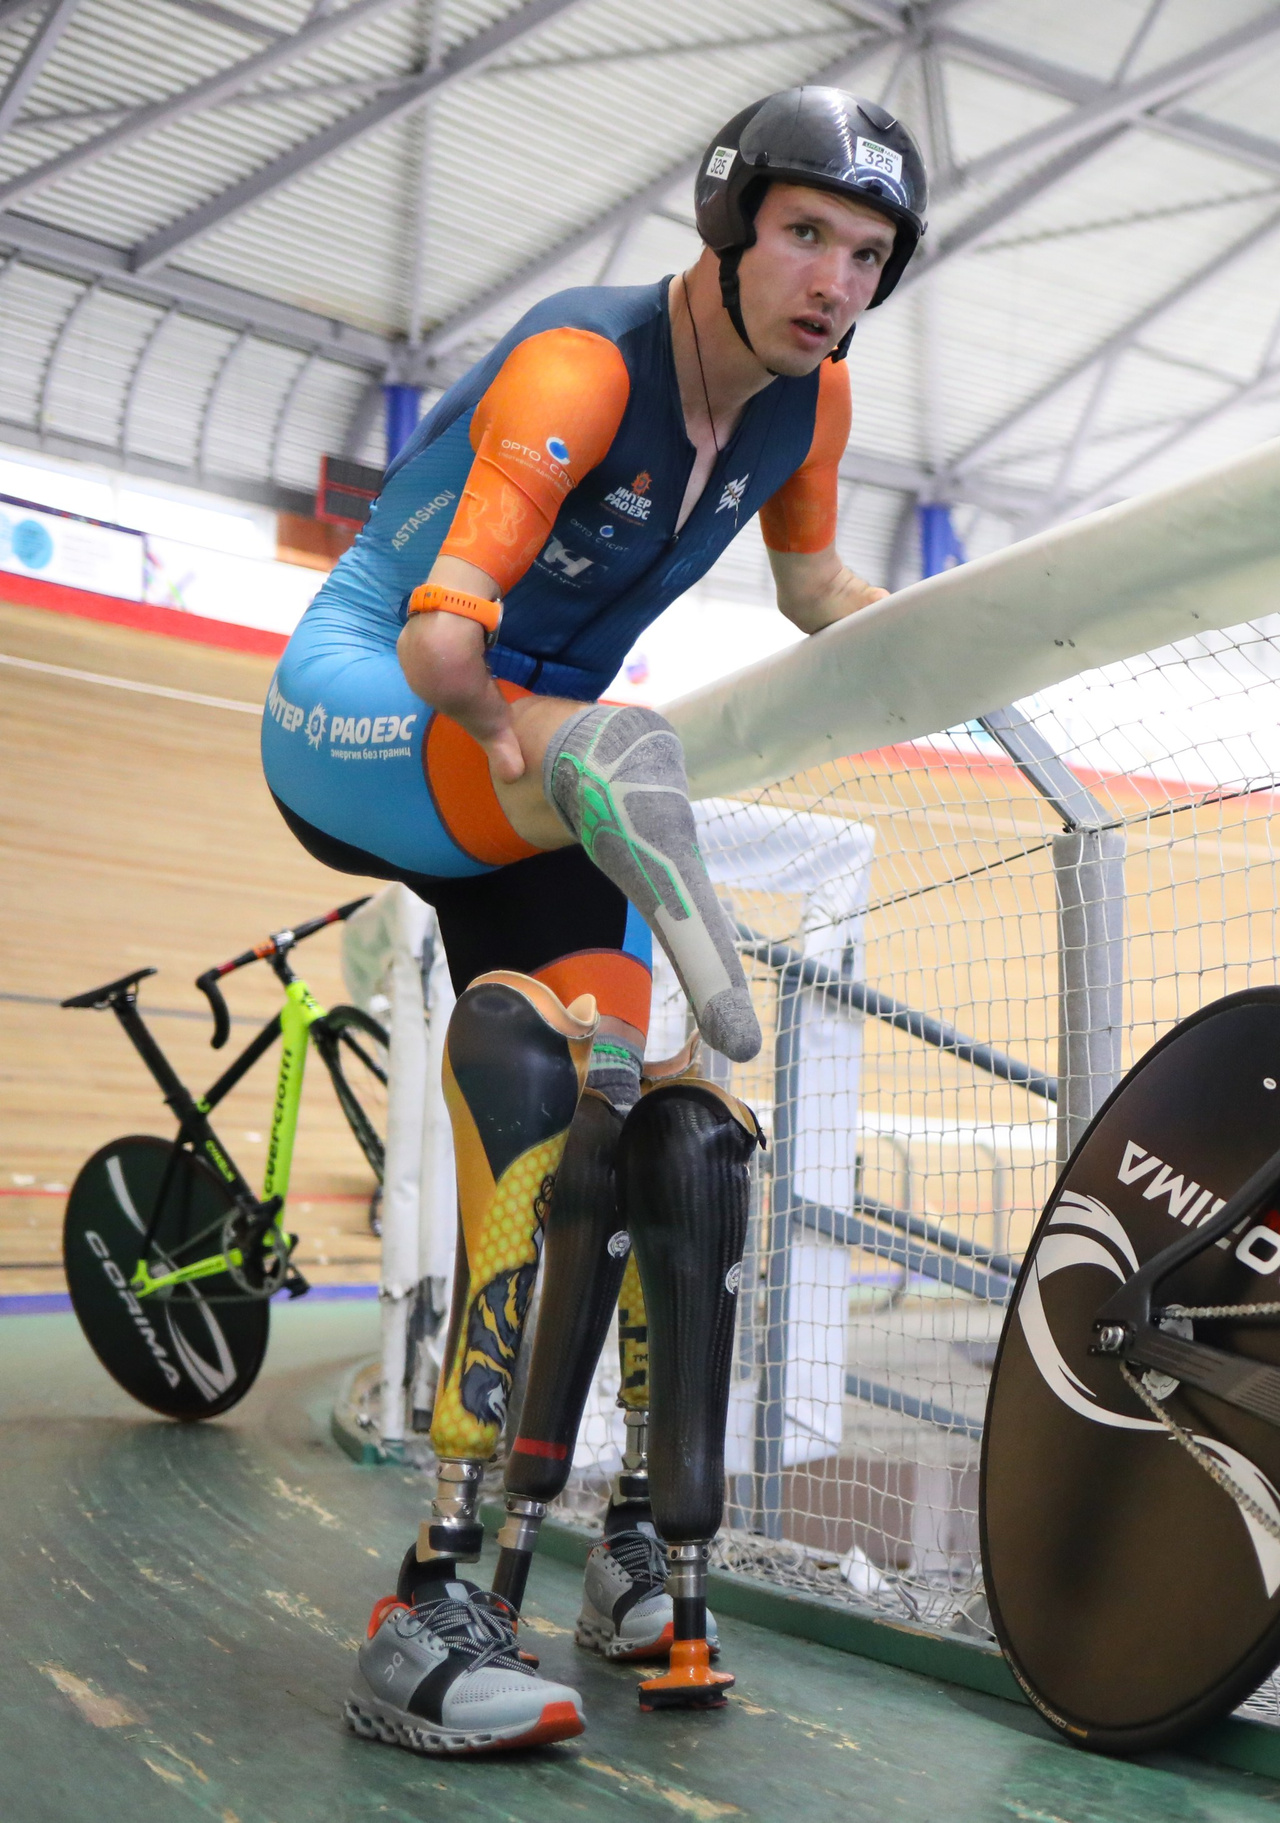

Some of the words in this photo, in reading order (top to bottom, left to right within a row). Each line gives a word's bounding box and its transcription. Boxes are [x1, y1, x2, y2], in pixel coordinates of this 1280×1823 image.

[710, 158, 727, 175] 325
[865, 149, 893, 173] 325
[614, 486, 652, 509] ИНТЕР
[391, 489, 456, 552] ASTASHOV
[330, 749, 362, 760] энергия
[363, 748, 377, 760] без
[379, 747, 411, 760] границ
[84, 1230, 181, 1389] CORIMA
